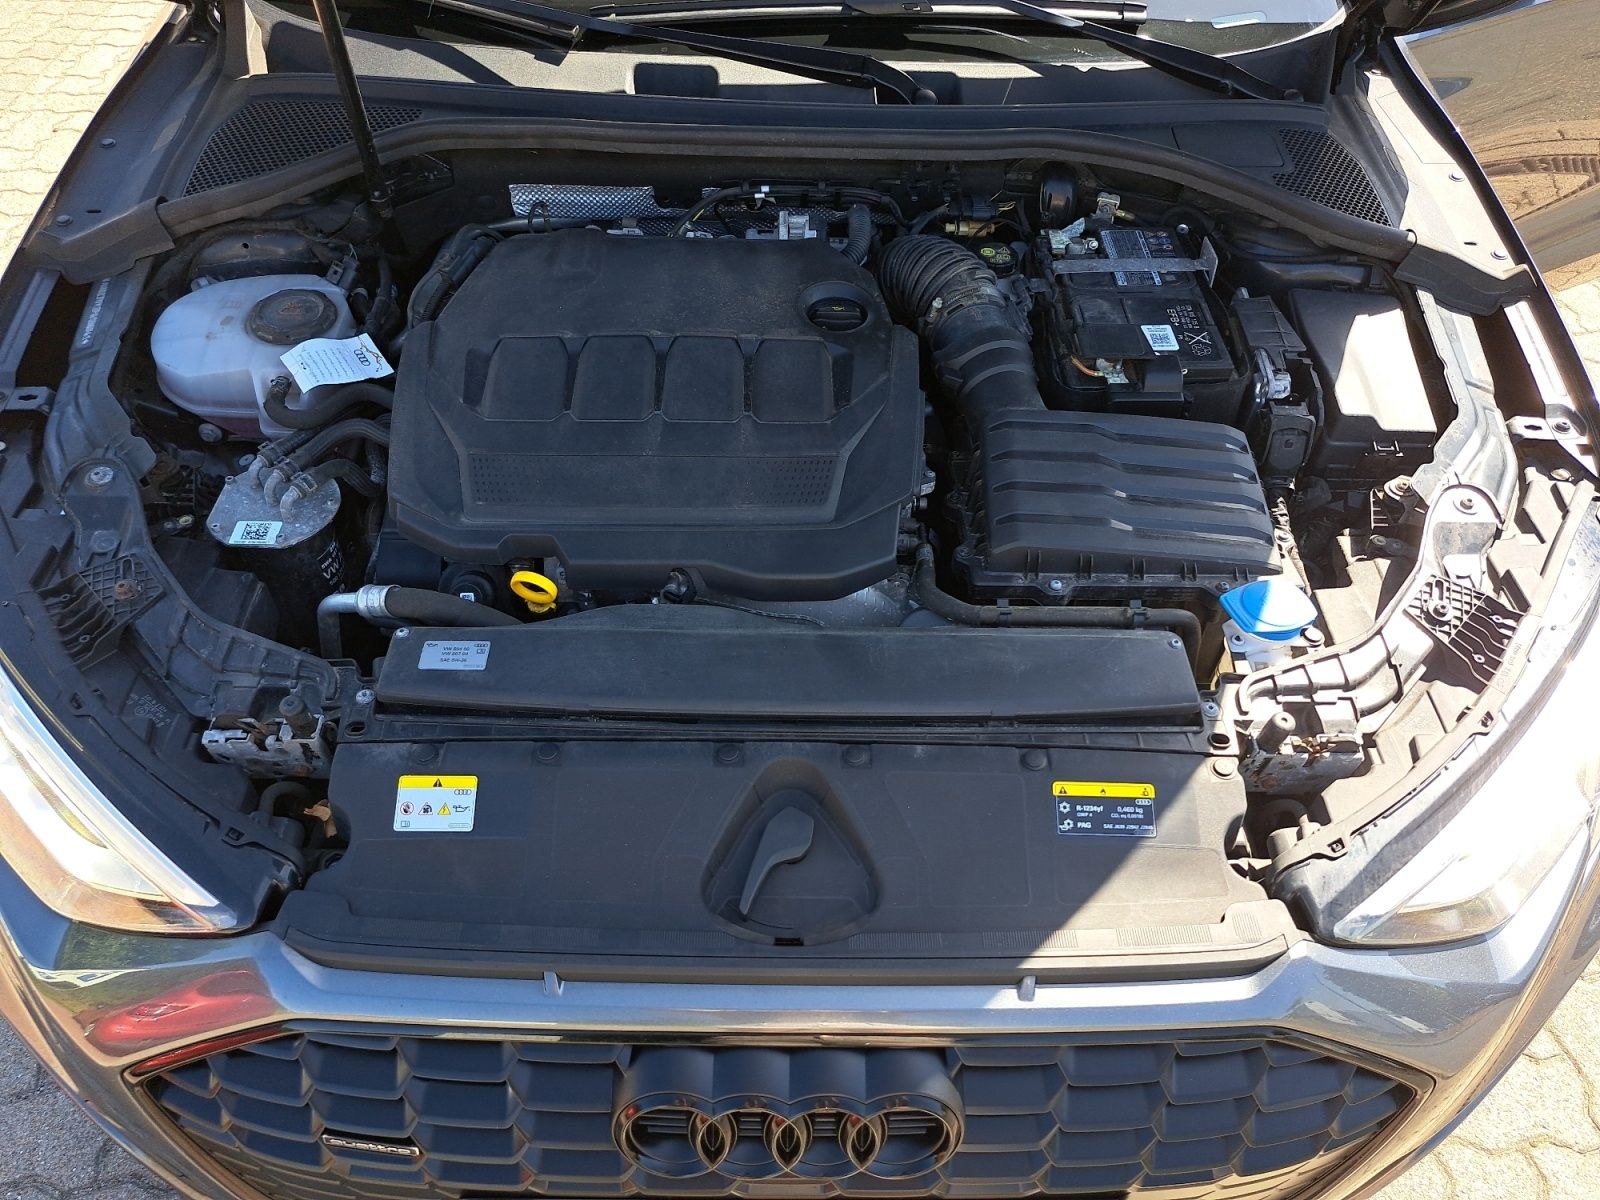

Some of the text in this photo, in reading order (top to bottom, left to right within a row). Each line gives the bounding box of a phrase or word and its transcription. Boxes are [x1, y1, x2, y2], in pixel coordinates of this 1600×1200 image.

[1076, 805, 1104, 813] R-1234yf
[1136, 806, 1144, 814] kg
[1078, 821, 1092, 829] PAG
[329, 1138, 411, 1154] quattro
